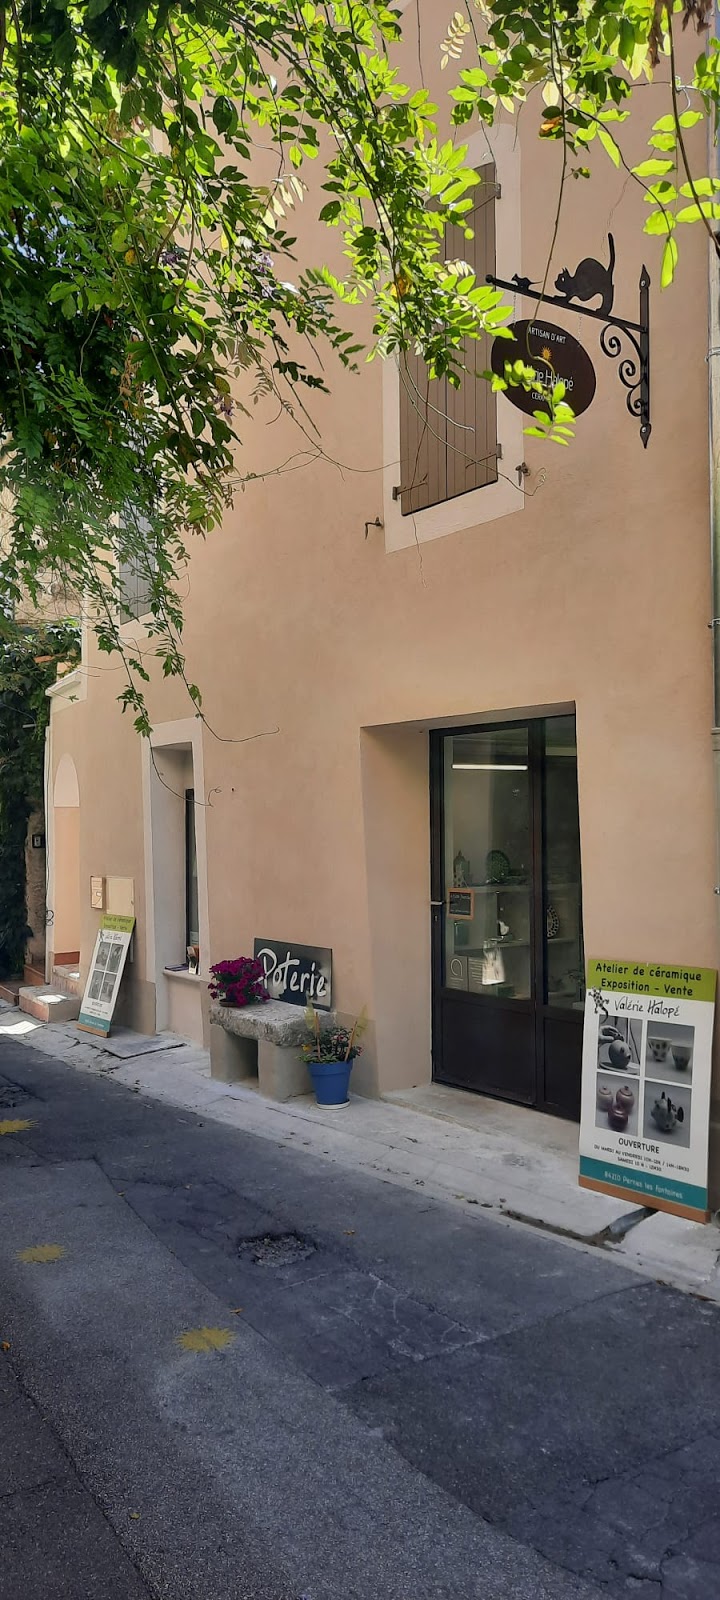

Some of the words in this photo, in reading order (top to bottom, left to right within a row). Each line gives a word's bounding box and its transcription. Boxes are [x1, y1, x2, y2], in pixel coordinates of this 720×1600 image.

[528, 326, 550, 340] ARTISAN
[551, 333, 566, 344] D'ART
[254, 948, 327, 997] Poterie
[595, 963, 629, 975] Atelier
[633, 966, 645, 976] de
[649, 967, 702, 983] céramique
[601, 978, 650, 992] Exposition
[664, 984, 693, 996] Vente
[614, 996, 644, 1012] Valérie
[647, 1000, 680, 1018] Halopé
[618, 1137, 660, 1154] OUVERTURE
[622, 1175, 643, 1188] Pernes
[644, 1182, 653, 1191] les
